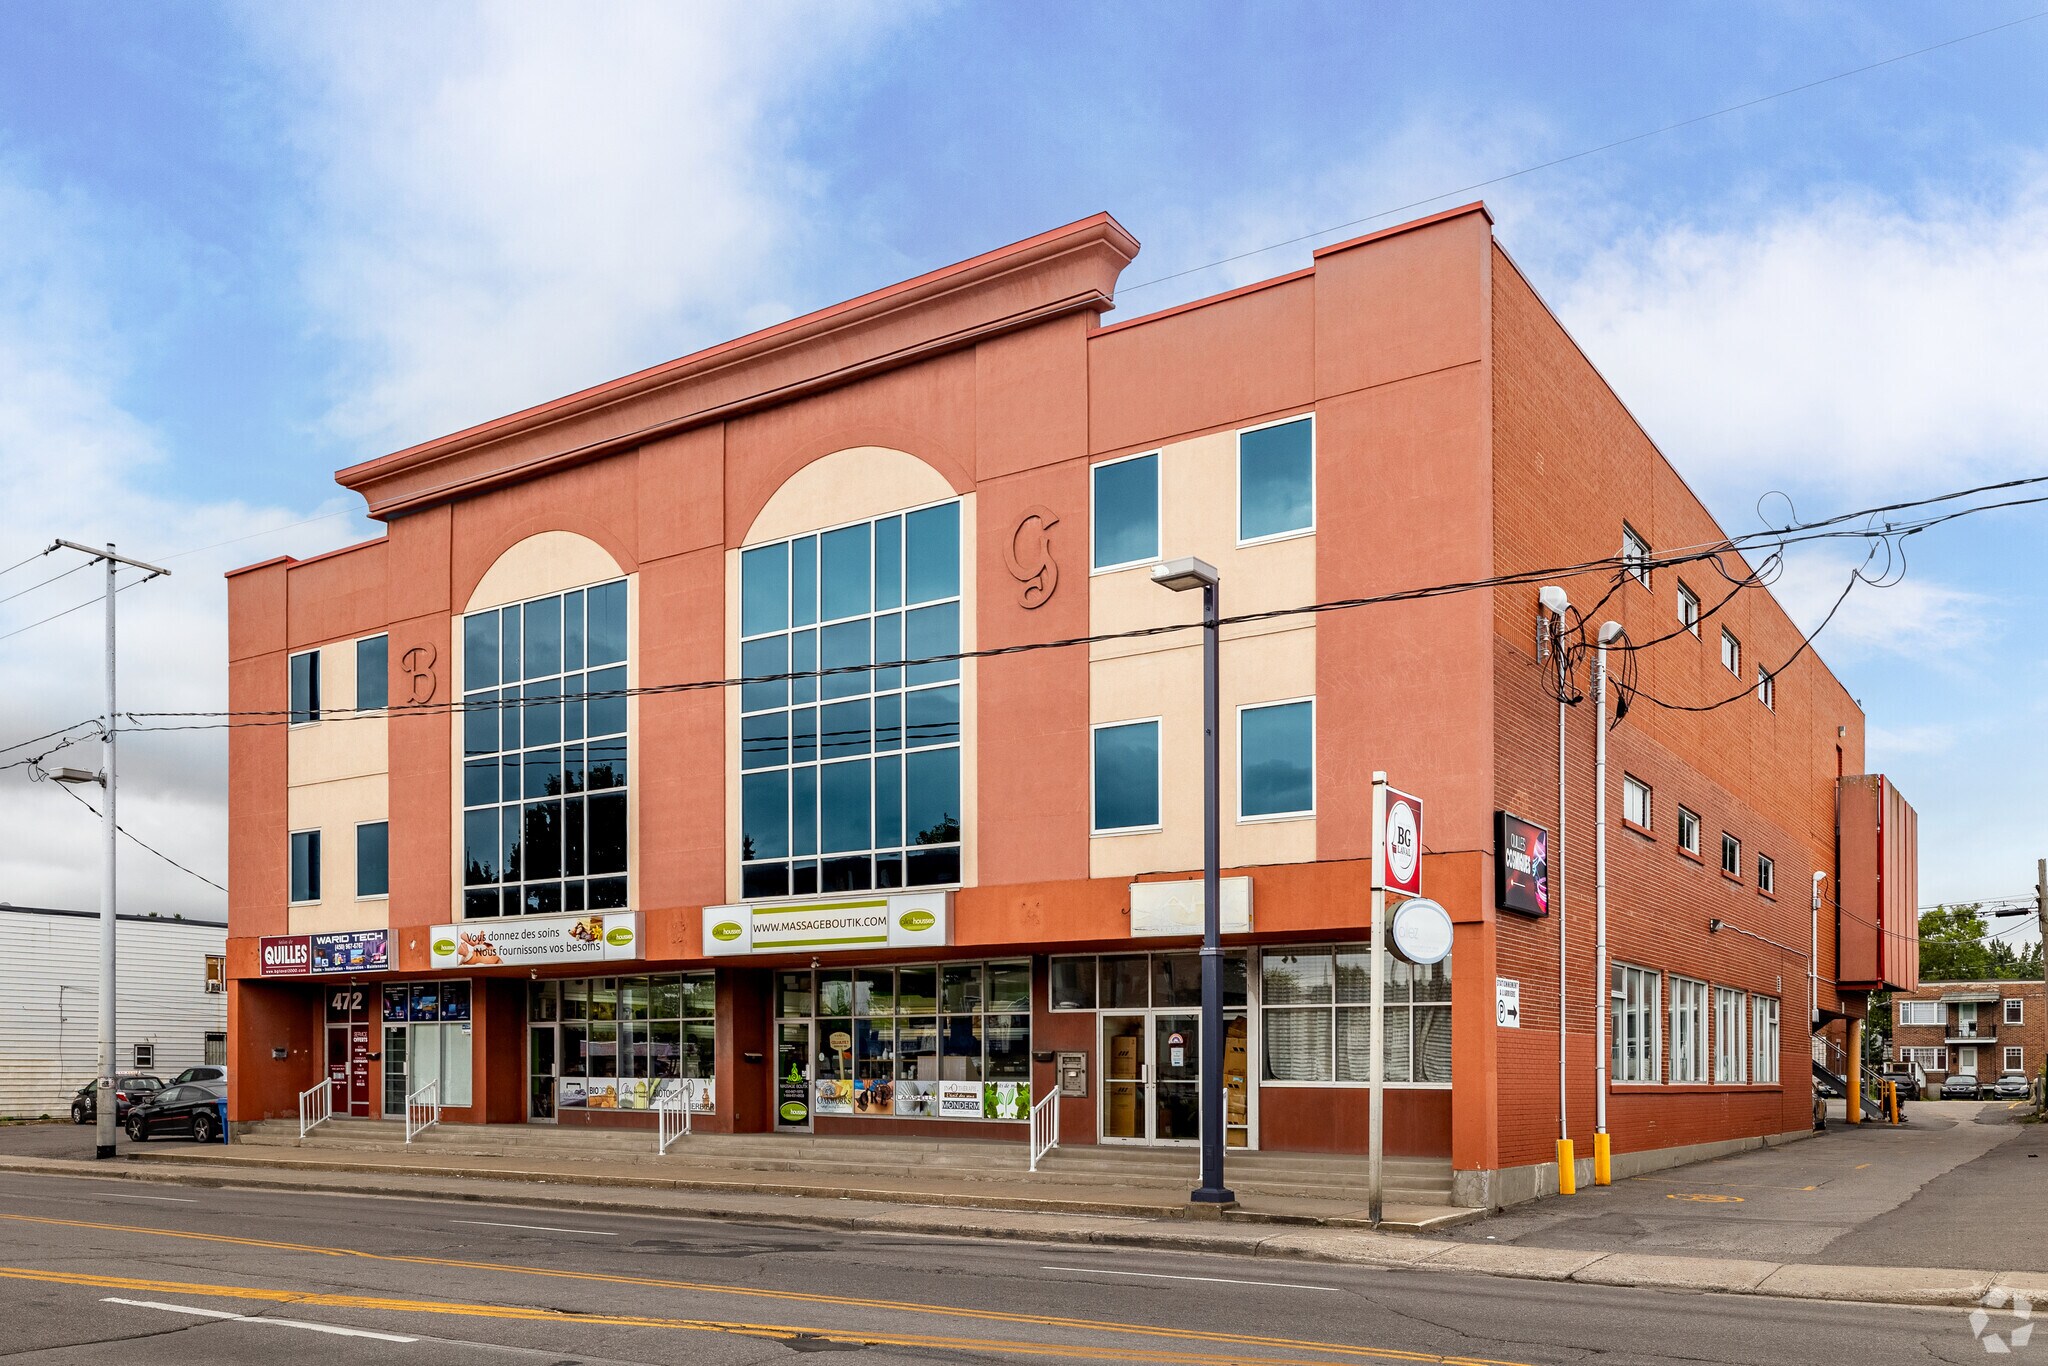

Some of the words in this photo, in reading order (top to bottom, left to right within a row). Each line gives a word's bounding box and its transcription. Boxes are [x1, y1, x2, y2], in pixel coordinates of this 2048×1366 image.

[401, 641, 437, 704] B
[1397, 826, 1411, 848] BG
[753, 916, 887, 933] WWW.MASSAGEBOUTIK.COM
[316, 934, 349, 944] WARID
[352, 932, 383, 942] TECH
[466, 932, 486, 942] Vous
[488, 931, 519, 941] donnez
[521, 929, 536, 939] des
[538, 928, 560, 938] soins
[264, 944, 308, 965] QUILLES
[475, 947, 497, 957] Nous
[499, 944, 548, 956] fournissons
[549, 945, 564, 953] vos
[566, 942, 601, 952] besoins
[331, 991, 363, 1010] 472
